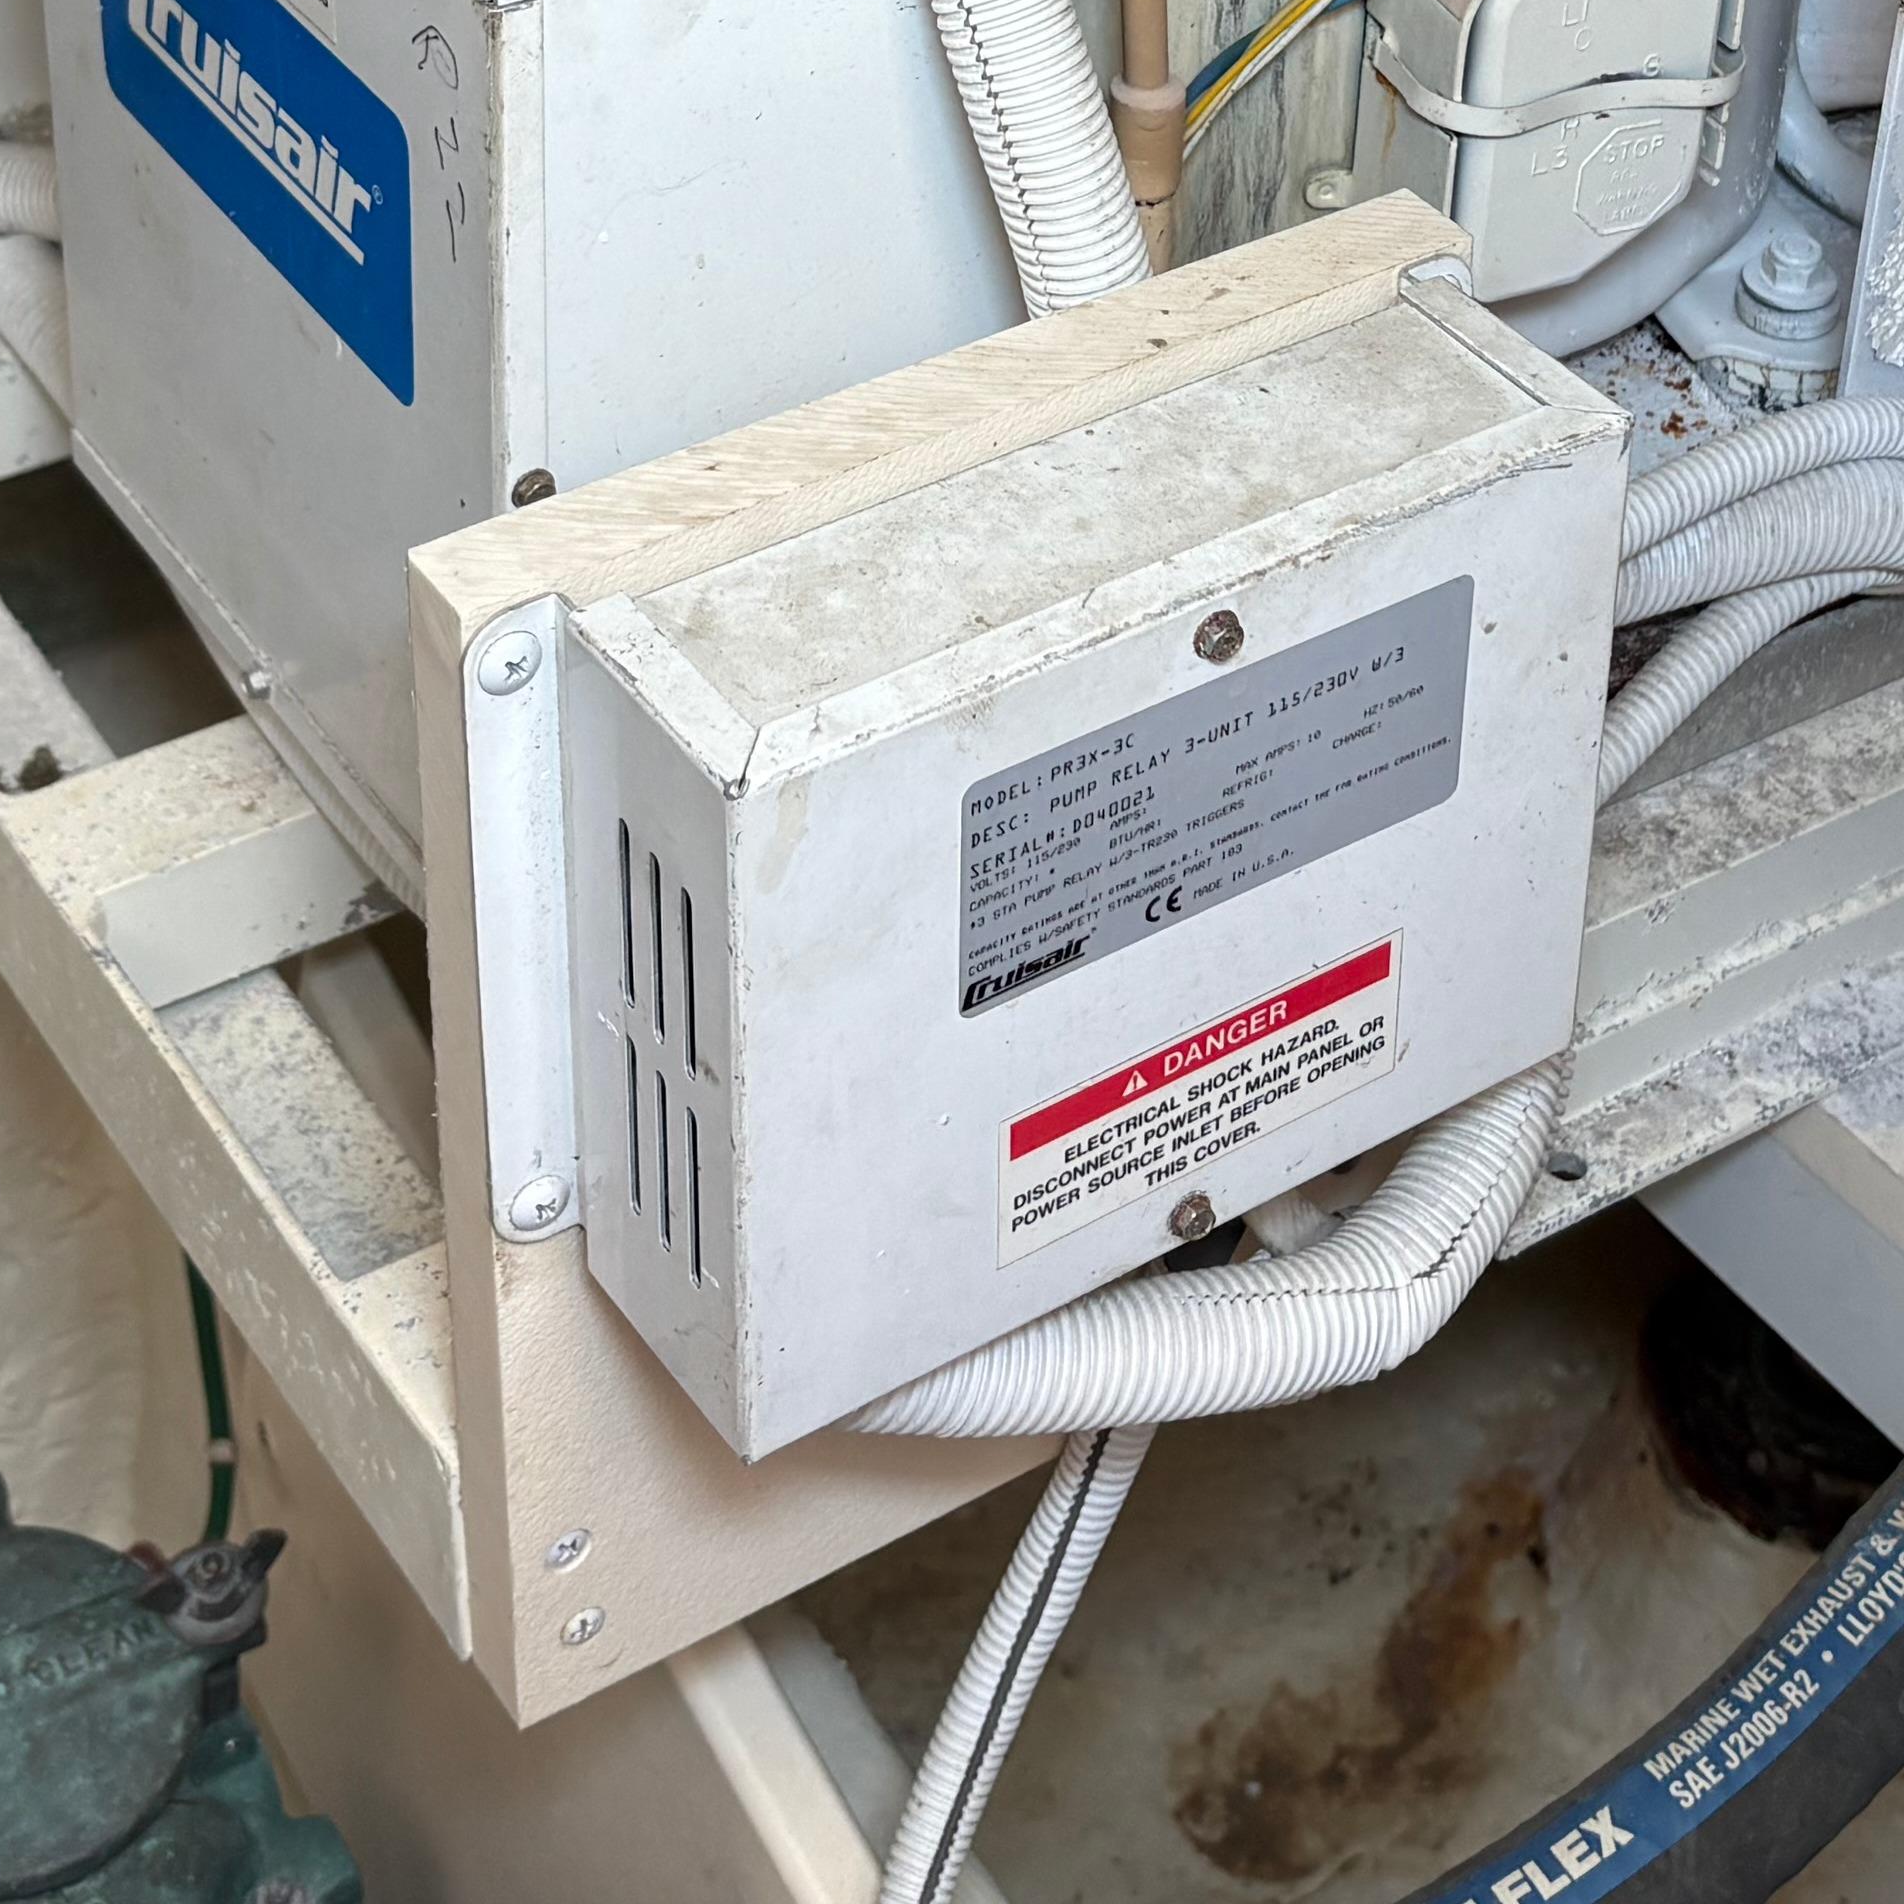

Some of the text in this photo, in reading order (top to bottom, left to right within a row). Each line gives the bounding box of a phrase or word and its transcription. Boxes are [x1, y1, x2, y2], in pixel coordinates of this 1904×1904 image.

[1604, 133, 1665, 164] STOP
[970, 732, 1134, 817] MODEL: PR3X-3C
[971, 812, 1029, 849] DESC:
[1049, 780, 1097, 814] PUMP
[1111, 747, 1171, 787] RELAY
[1184, 711, 1254, 754] 3-UNIT
[1268, 665, 1359, 718] 115/230V
[1193, 848, 1294, 900] MADE IN U.S.A.
[962, 934, 1091, 1011] Cruisair
[1164, 1000, 1287, 1077] DANGER
[1011, 1035, 1385, 1233] POWER SOURCE INLET BEFORE OPENING
[1013, 1015, 1385, 1211] DISCONNECT POWER AT MAIN PANEL OR
[1064, 1018, 1340, 1164] ELECTRICAL SHOCK HAZARD.
[1144, 1120, 1261, 1187] THIS COVER.
[1643, 1696, 1741, 1783] MARINE
[1731, 1647, 1788, 1714] WET
[1779, 1553, 1876, 1656] EXHAUST
[1667, 1755, 1725, 1810] SAE
[1723, 1668, 1821, 1771] J2006-R2
[1462, 1804, 1635, 1904] FLEX
